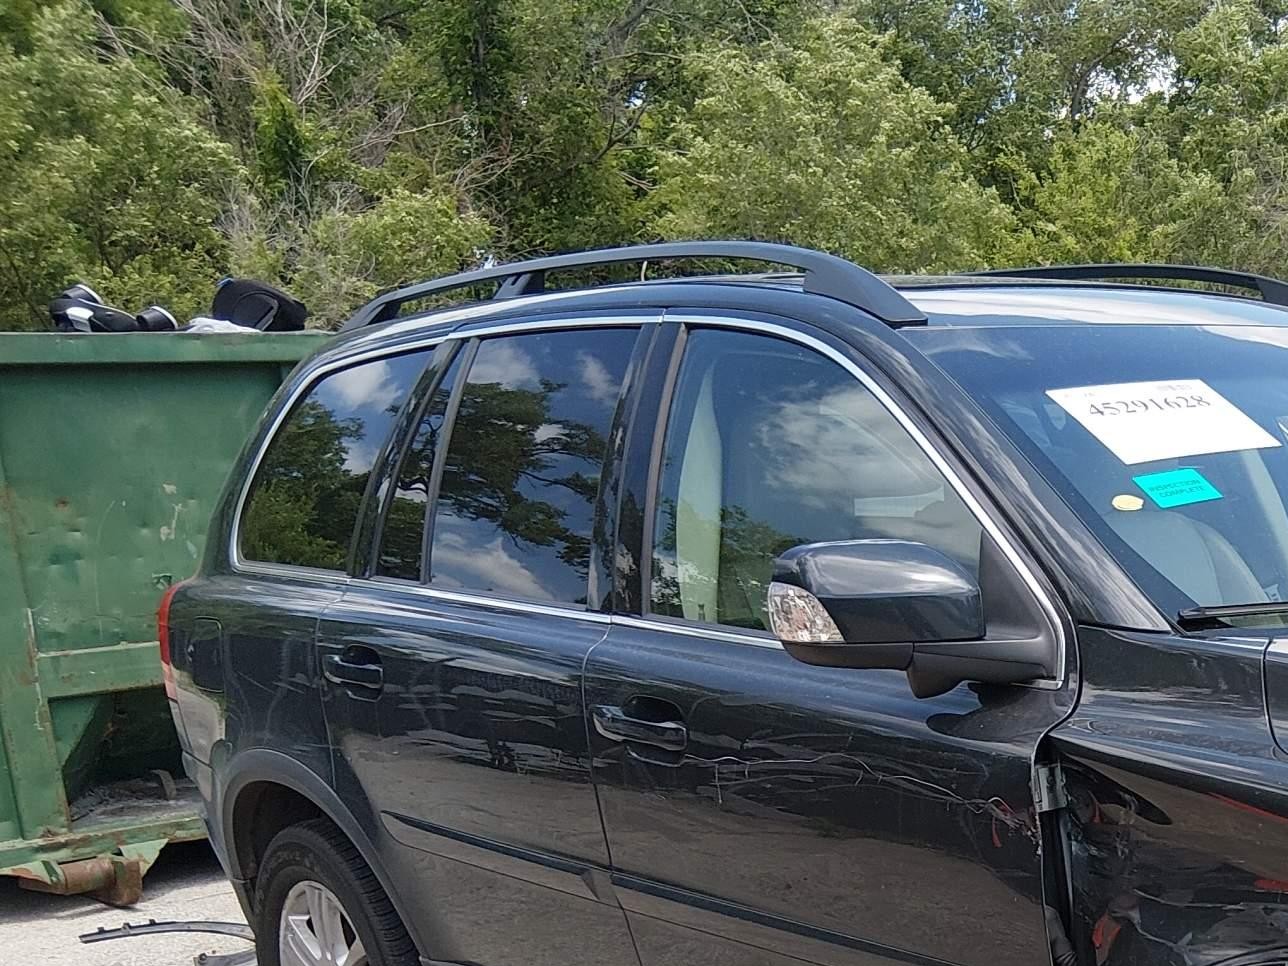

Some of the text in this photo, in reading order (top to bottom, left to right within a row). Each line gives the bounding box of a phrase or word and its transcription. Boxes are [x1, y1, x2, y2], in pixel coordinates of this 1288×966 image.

[1089, 395, 1211, 417] 45291628
[1147, 478, 1202, 493] INSPECTION
[1159, 484, 1206, 498] COMPLETE
